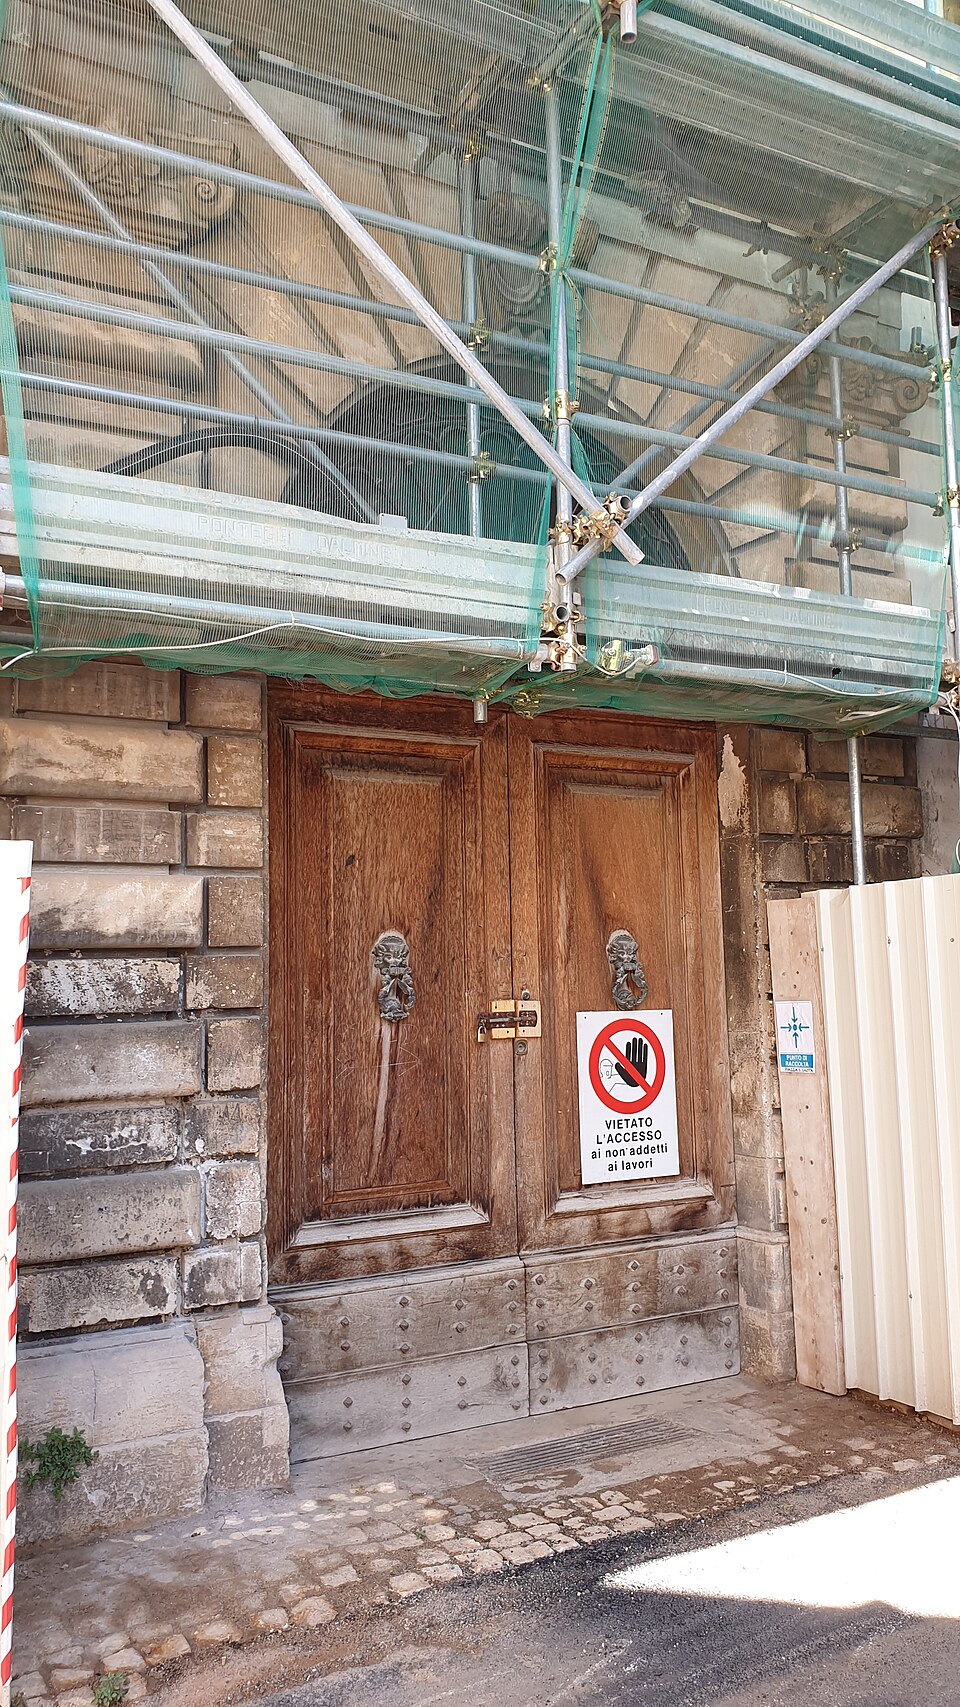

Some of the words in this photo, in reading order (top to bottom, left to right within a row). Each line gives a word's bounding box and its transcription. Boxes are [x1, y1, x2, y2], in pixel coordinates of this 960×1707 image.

[605, 1117, 653, 1130] VIETATO
[596, 1130, 662, 1145] L'ACCESSO
[591, 1148, 601, 1160] ai
[605, 1149, 626, 1158] non
[629, 1143, 668, 1156] addetti
[608, 1161, 618, 1172] ai
[621, 1158, 653, 1171] lavori
